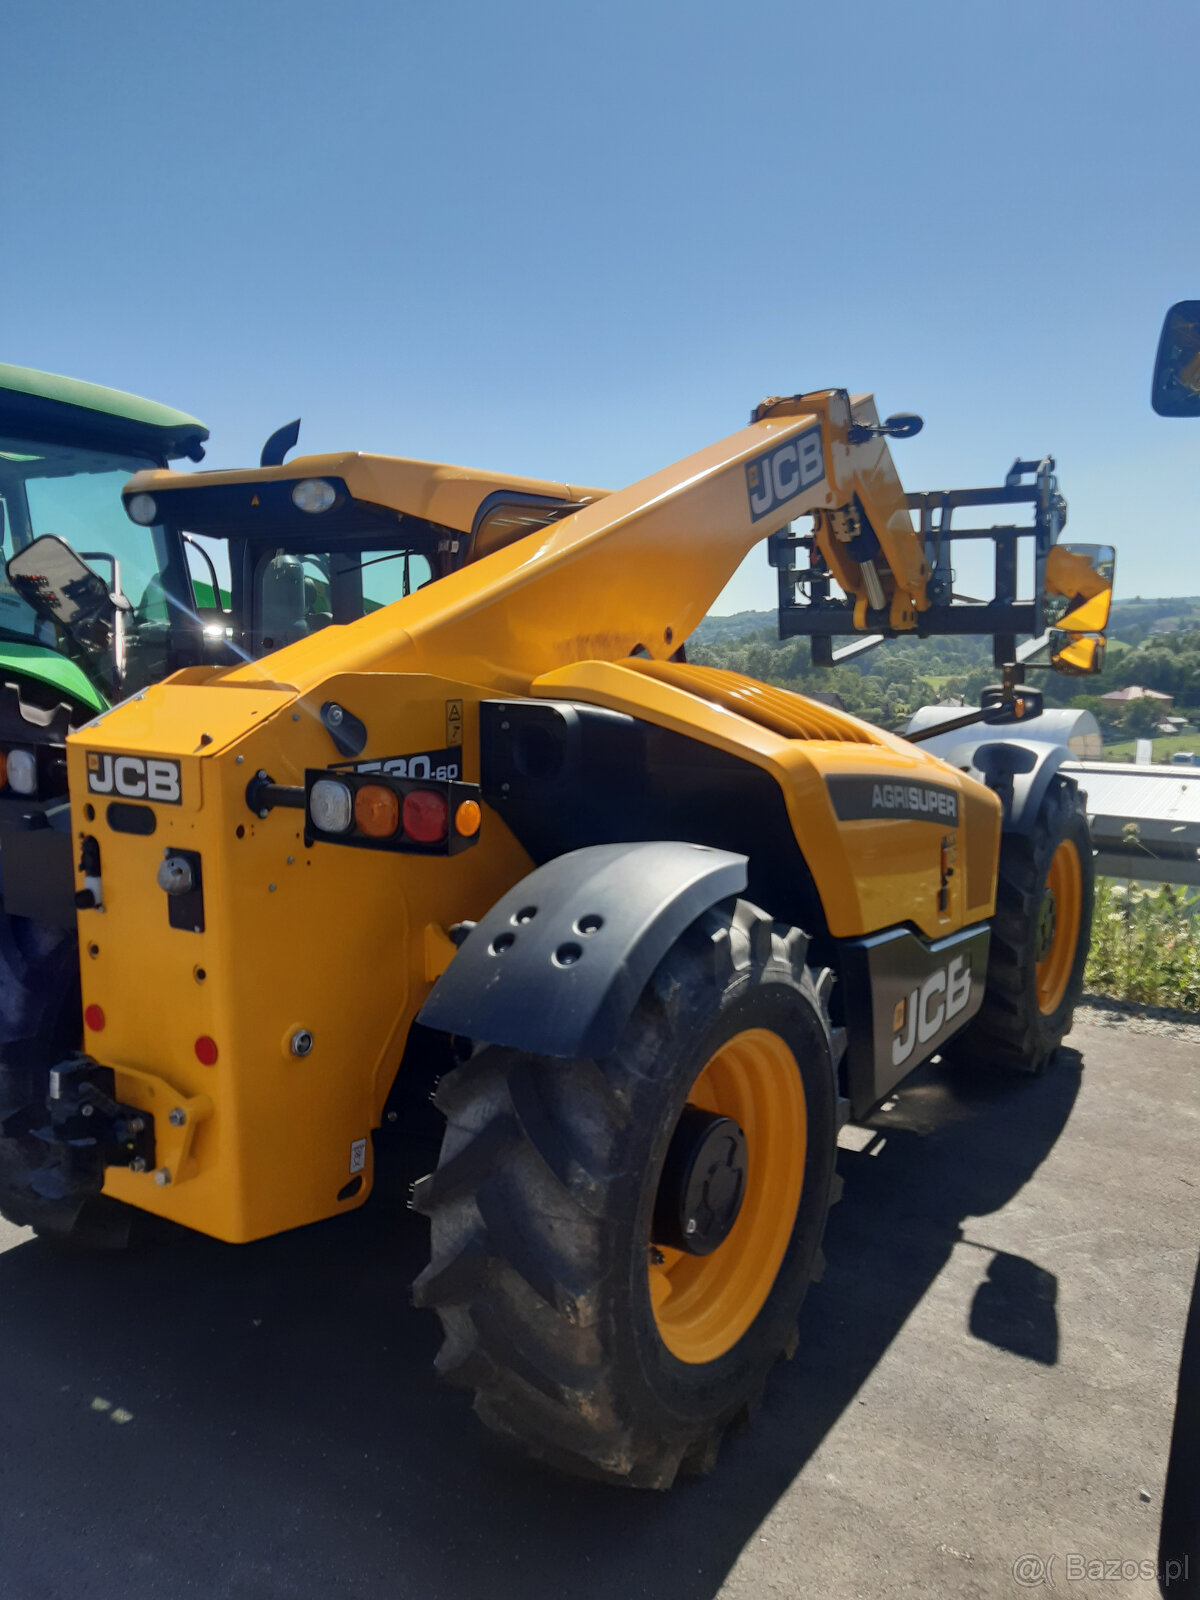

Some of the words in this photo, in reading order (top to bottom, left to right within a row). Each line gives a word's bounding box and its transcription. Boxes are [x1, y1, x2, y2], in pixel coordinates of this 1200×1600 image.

[751, 432, 823, 514] JCB
[89, 755, 180, 802] JCB
[872, 784, 957, 817] AGRISUPER
[892, 953, 971, 1066] JCB
